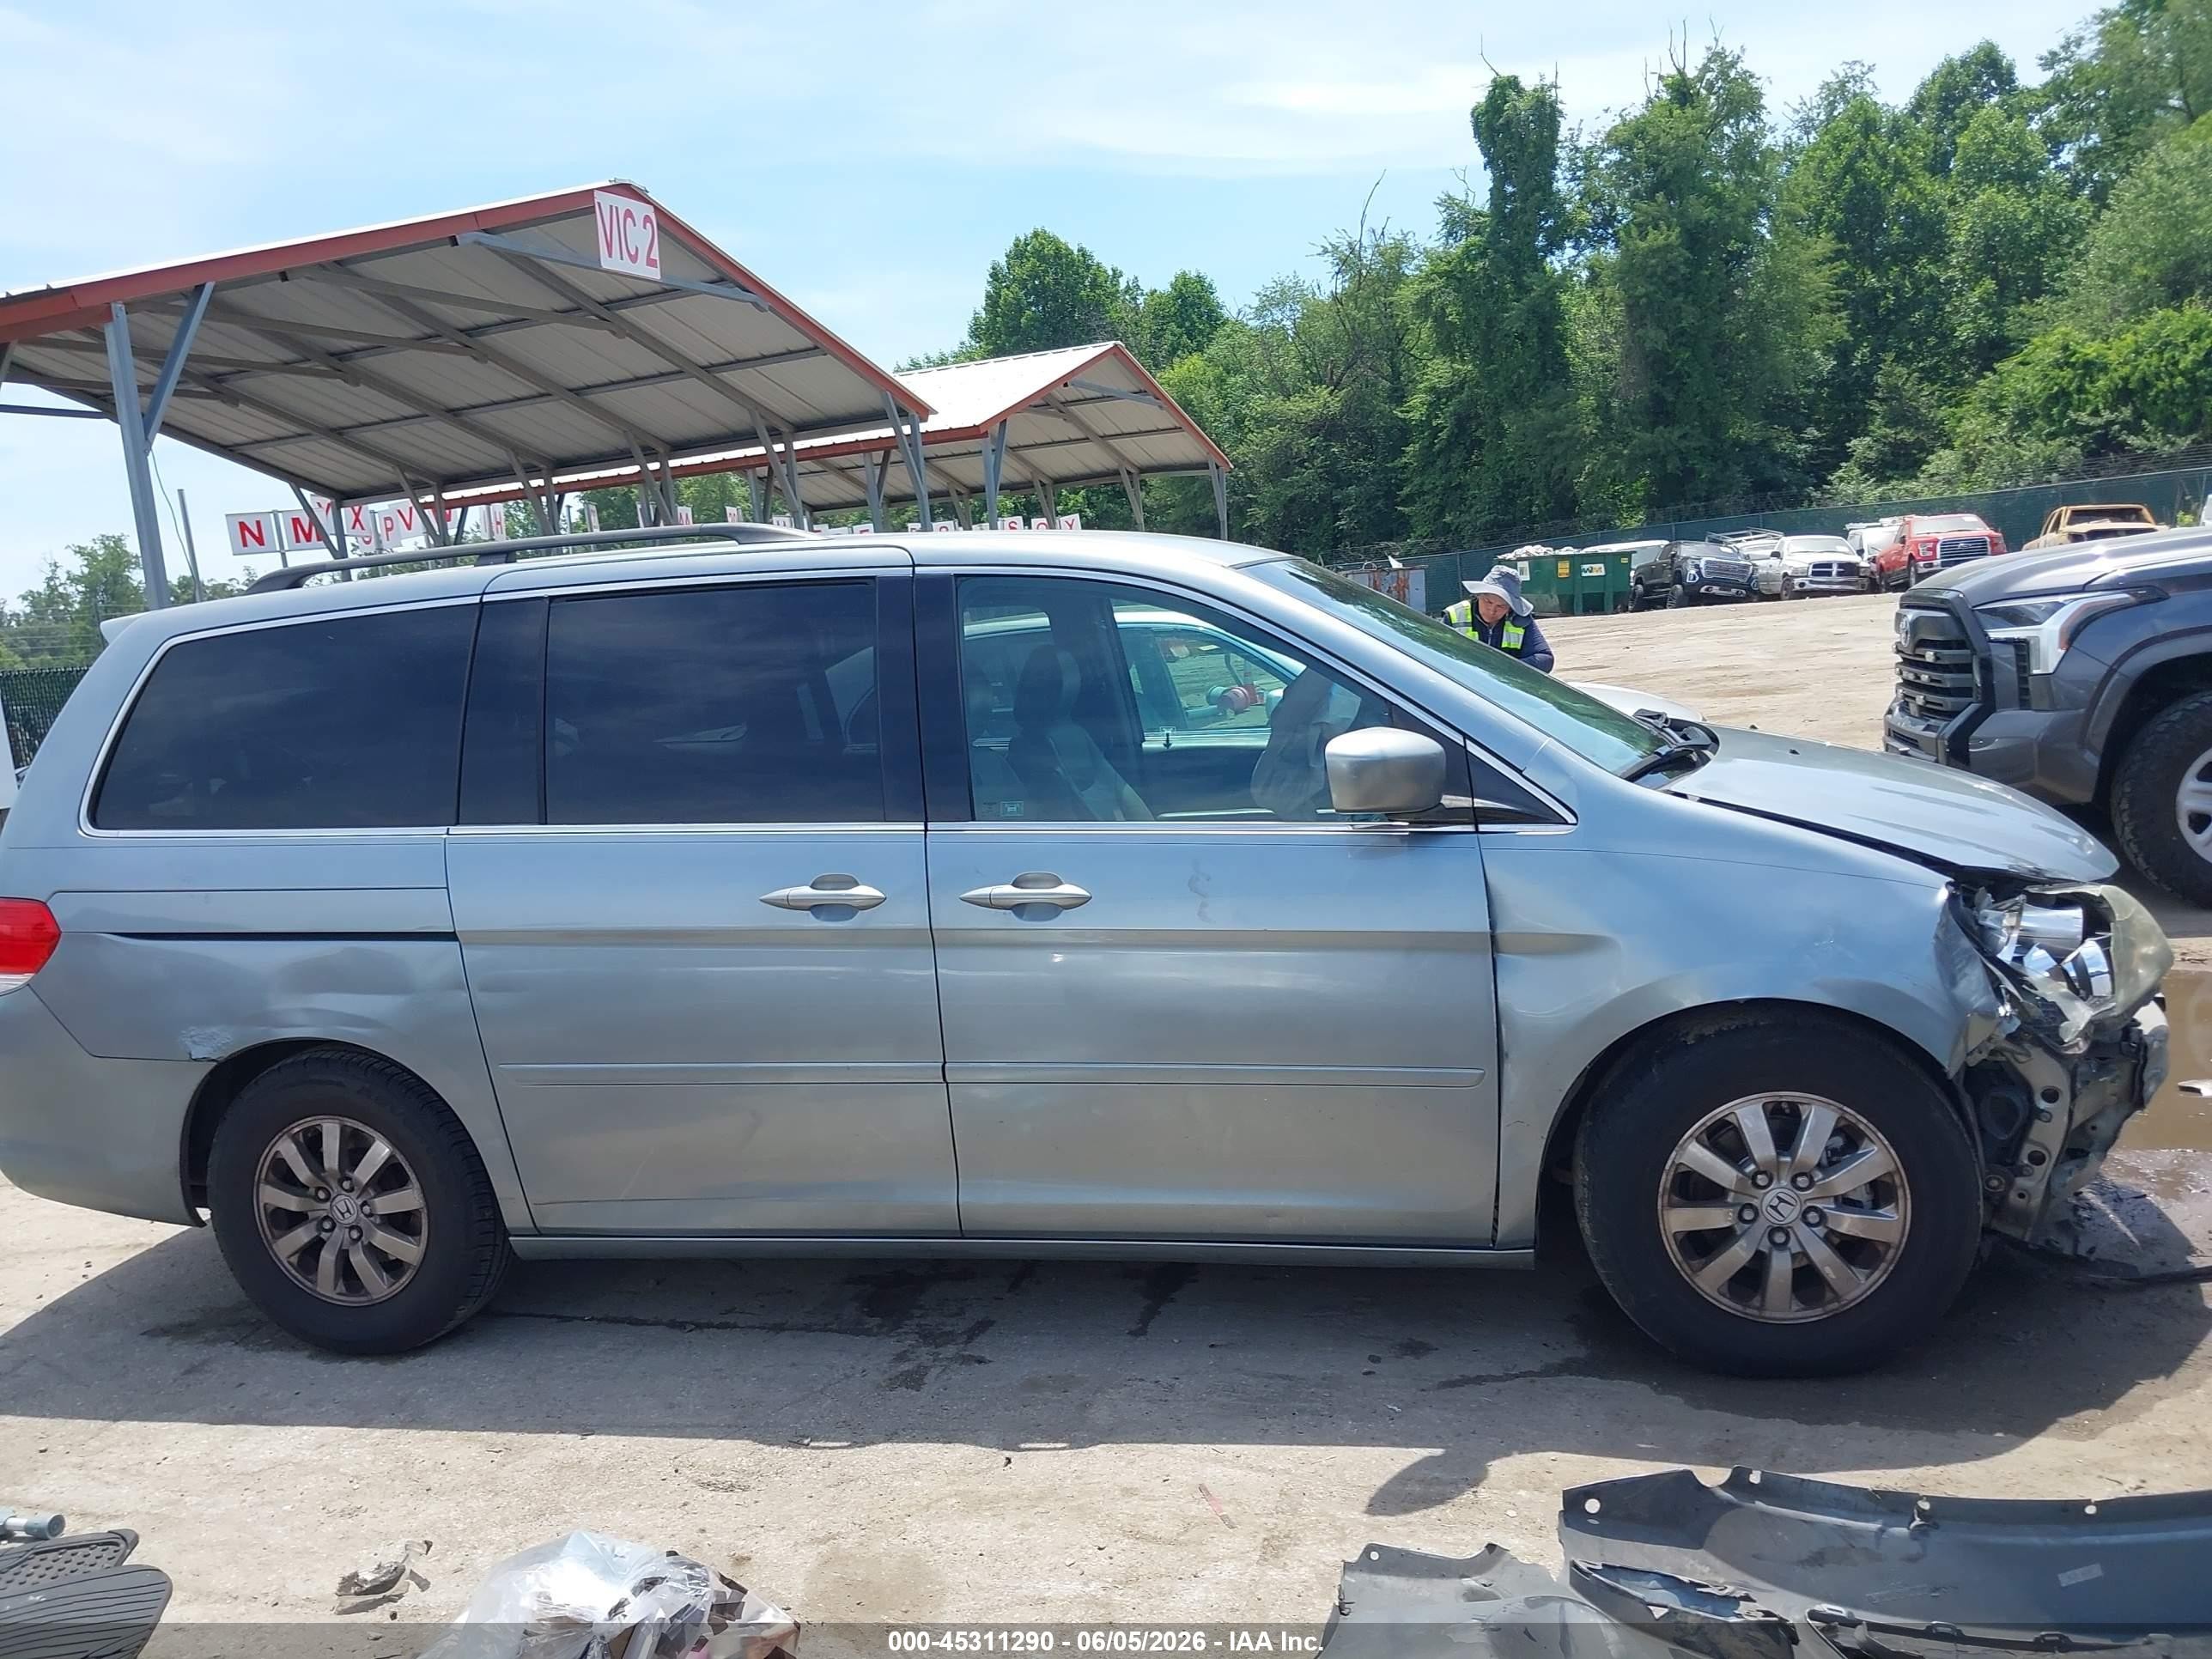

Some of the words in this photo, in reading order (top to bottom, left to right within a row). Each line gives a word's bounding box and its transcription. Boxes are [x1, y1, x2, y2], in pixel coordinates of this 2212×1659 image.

[597, 201, 639, 264] VIC
[642, 214, 658, 268] 2
[291, 517, 324, 544] M
[350, 505, 365, 531] X
[384, 516, 393, 541] P
[398, 507, 413, 531] V
[238, 520, 265, 548] N
